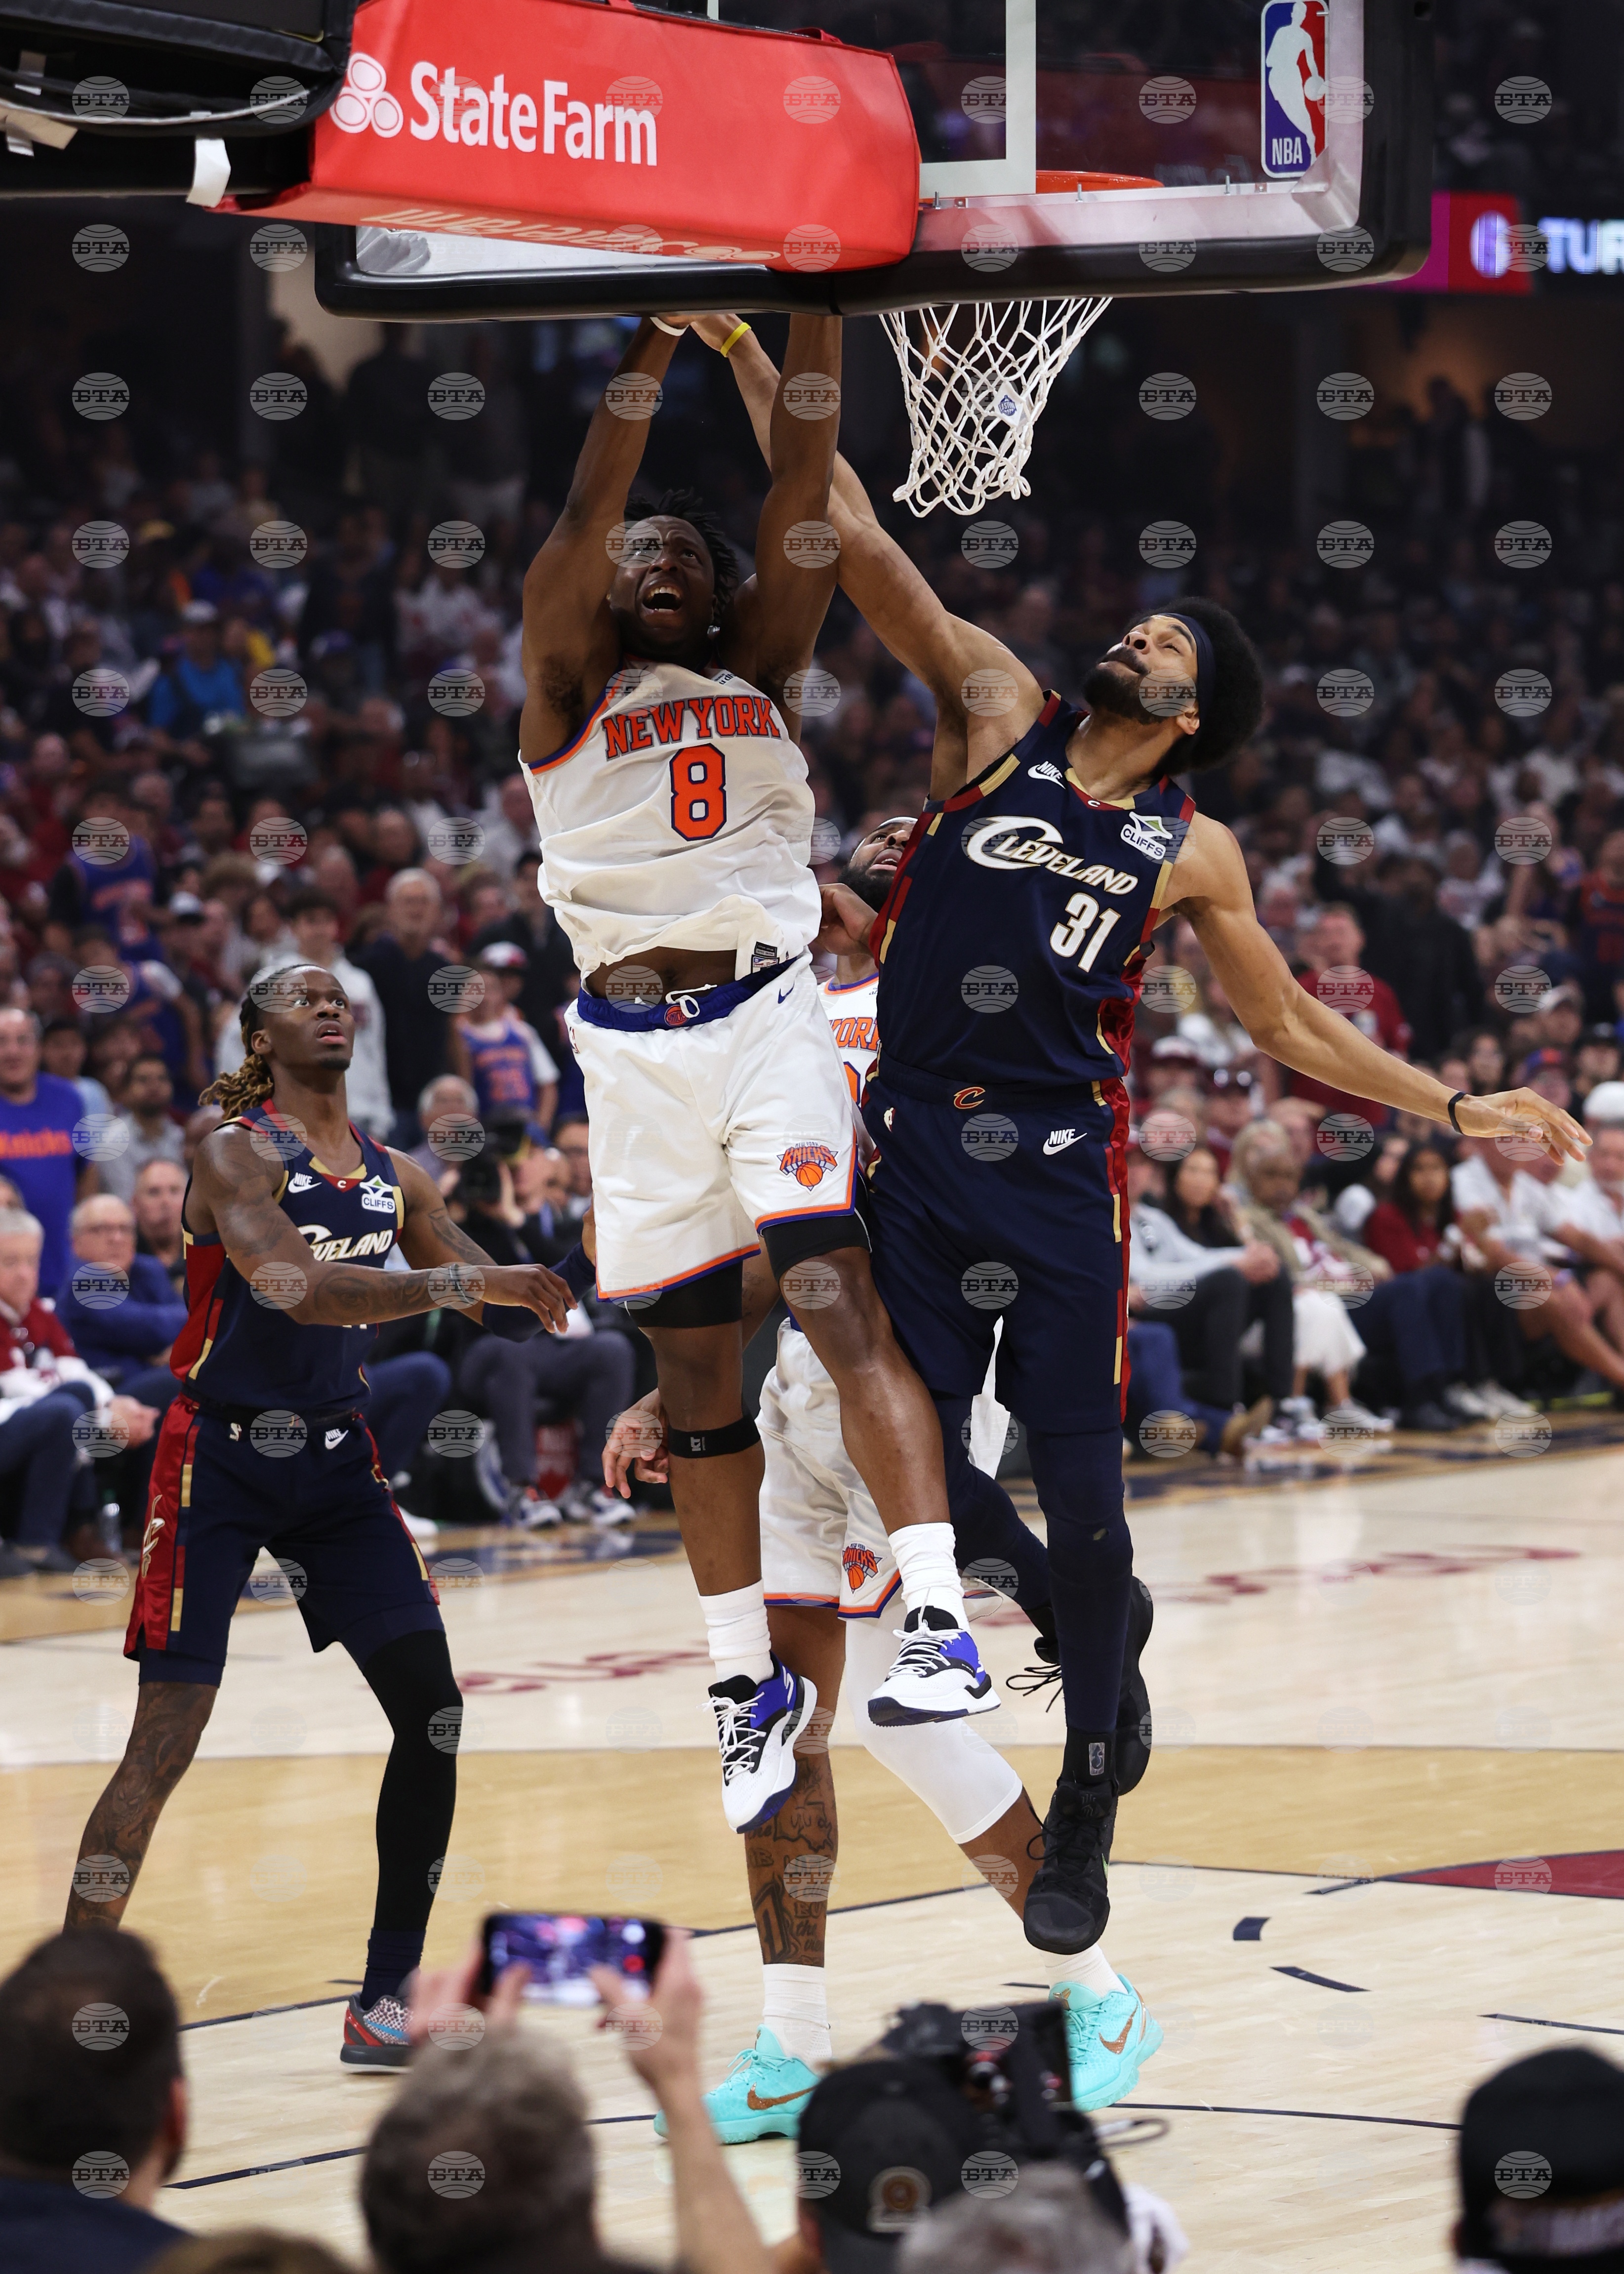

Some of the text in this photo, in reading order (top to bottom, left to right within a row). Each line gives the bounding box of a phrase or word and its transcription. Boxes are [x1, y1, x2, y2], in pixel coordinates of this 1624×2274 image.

[1272, 137, 1303, 165] NBA
[601, 695, 782, 761] NEW YORK
[1037, 761, 1062, 781] NIKE
[669, 743, 727, 841] 8
[1123, 827, 1165, 858] CLIFFS
[1050, 892, 1121, 973] 31
[1049, 1128, 1076, 1145] NIKE
[779, 1145, 838, 1171] KNICKS
[293, 1172, 313, 1187] NIKE
[363, 1198, 394, 1210] CLIFFS
[325, 1428, 342, 1440] NIKE
[843, 1546, 878, 1573] KNICKS
